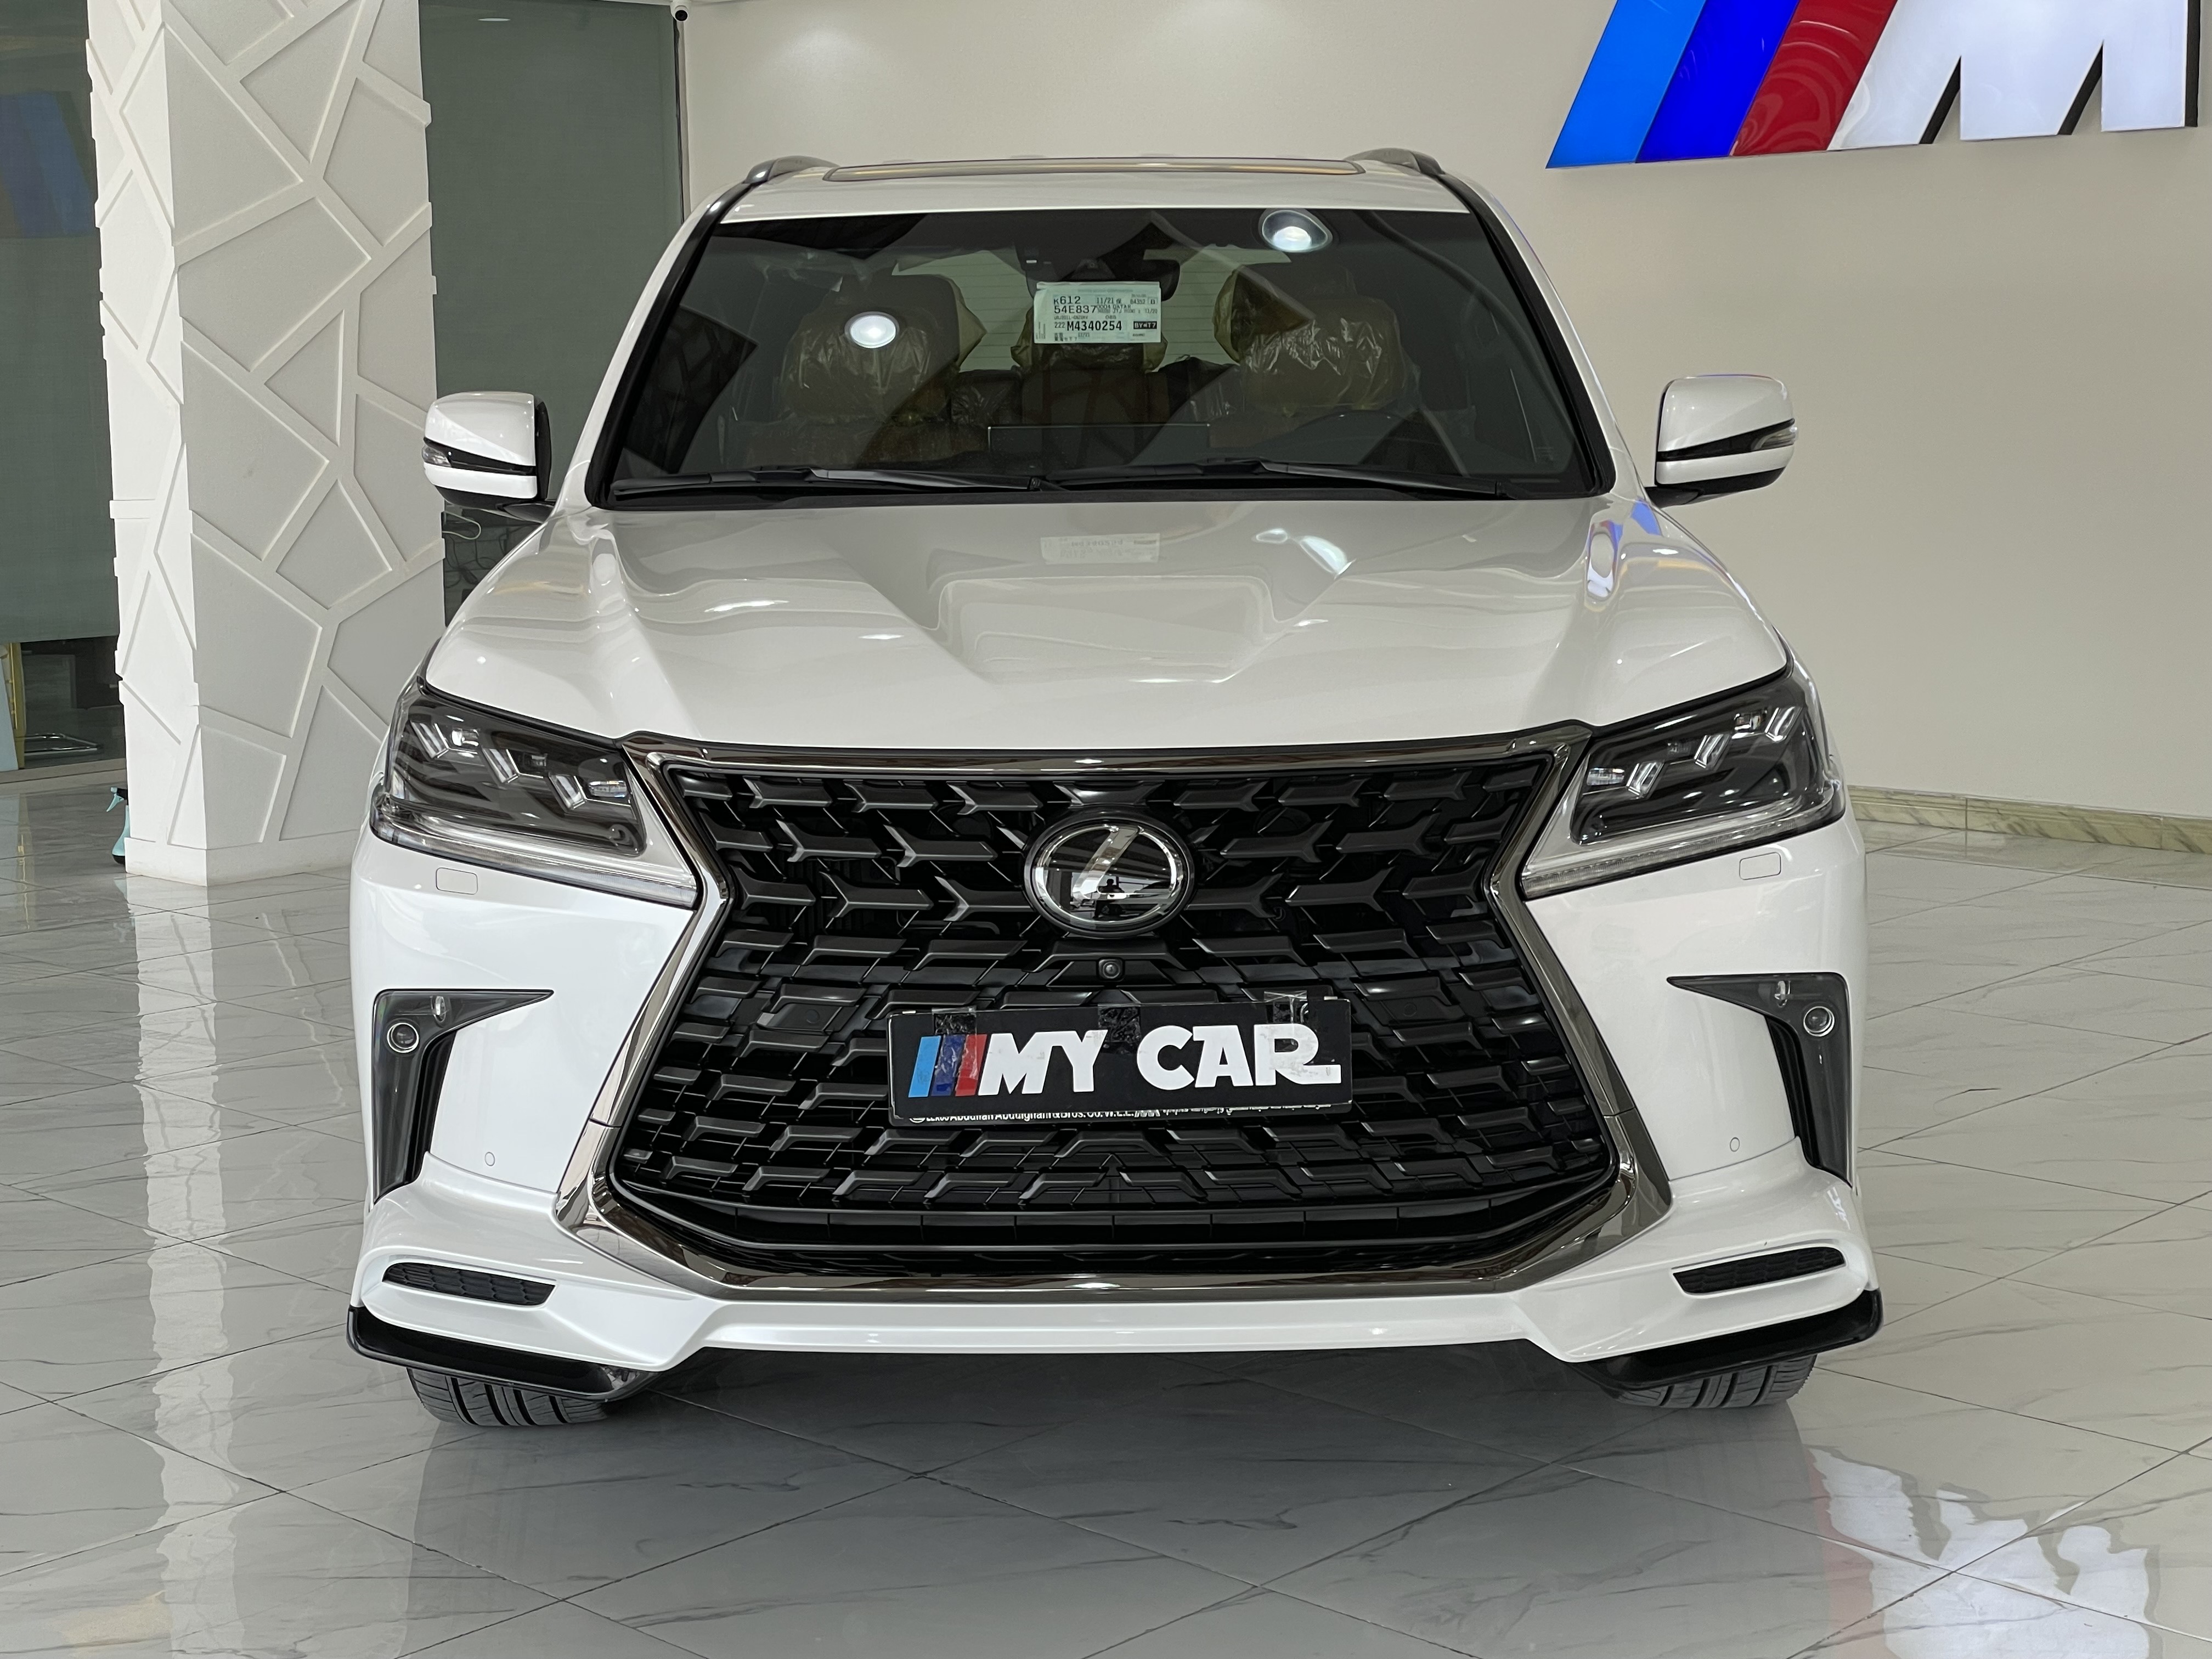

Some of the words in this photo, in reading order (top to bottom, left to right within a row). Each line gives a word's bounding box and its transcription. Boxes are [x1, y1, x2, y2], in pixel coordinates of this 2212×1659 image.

[1053, 296, 1081, 304] K612
[1054, 305, 1097, 313] 54E837
[1067, 321, 1122, 331] M4340254
[978, 1029, 1108, 1096] MY
[1137, 1023, 1341, 1090] CAR
